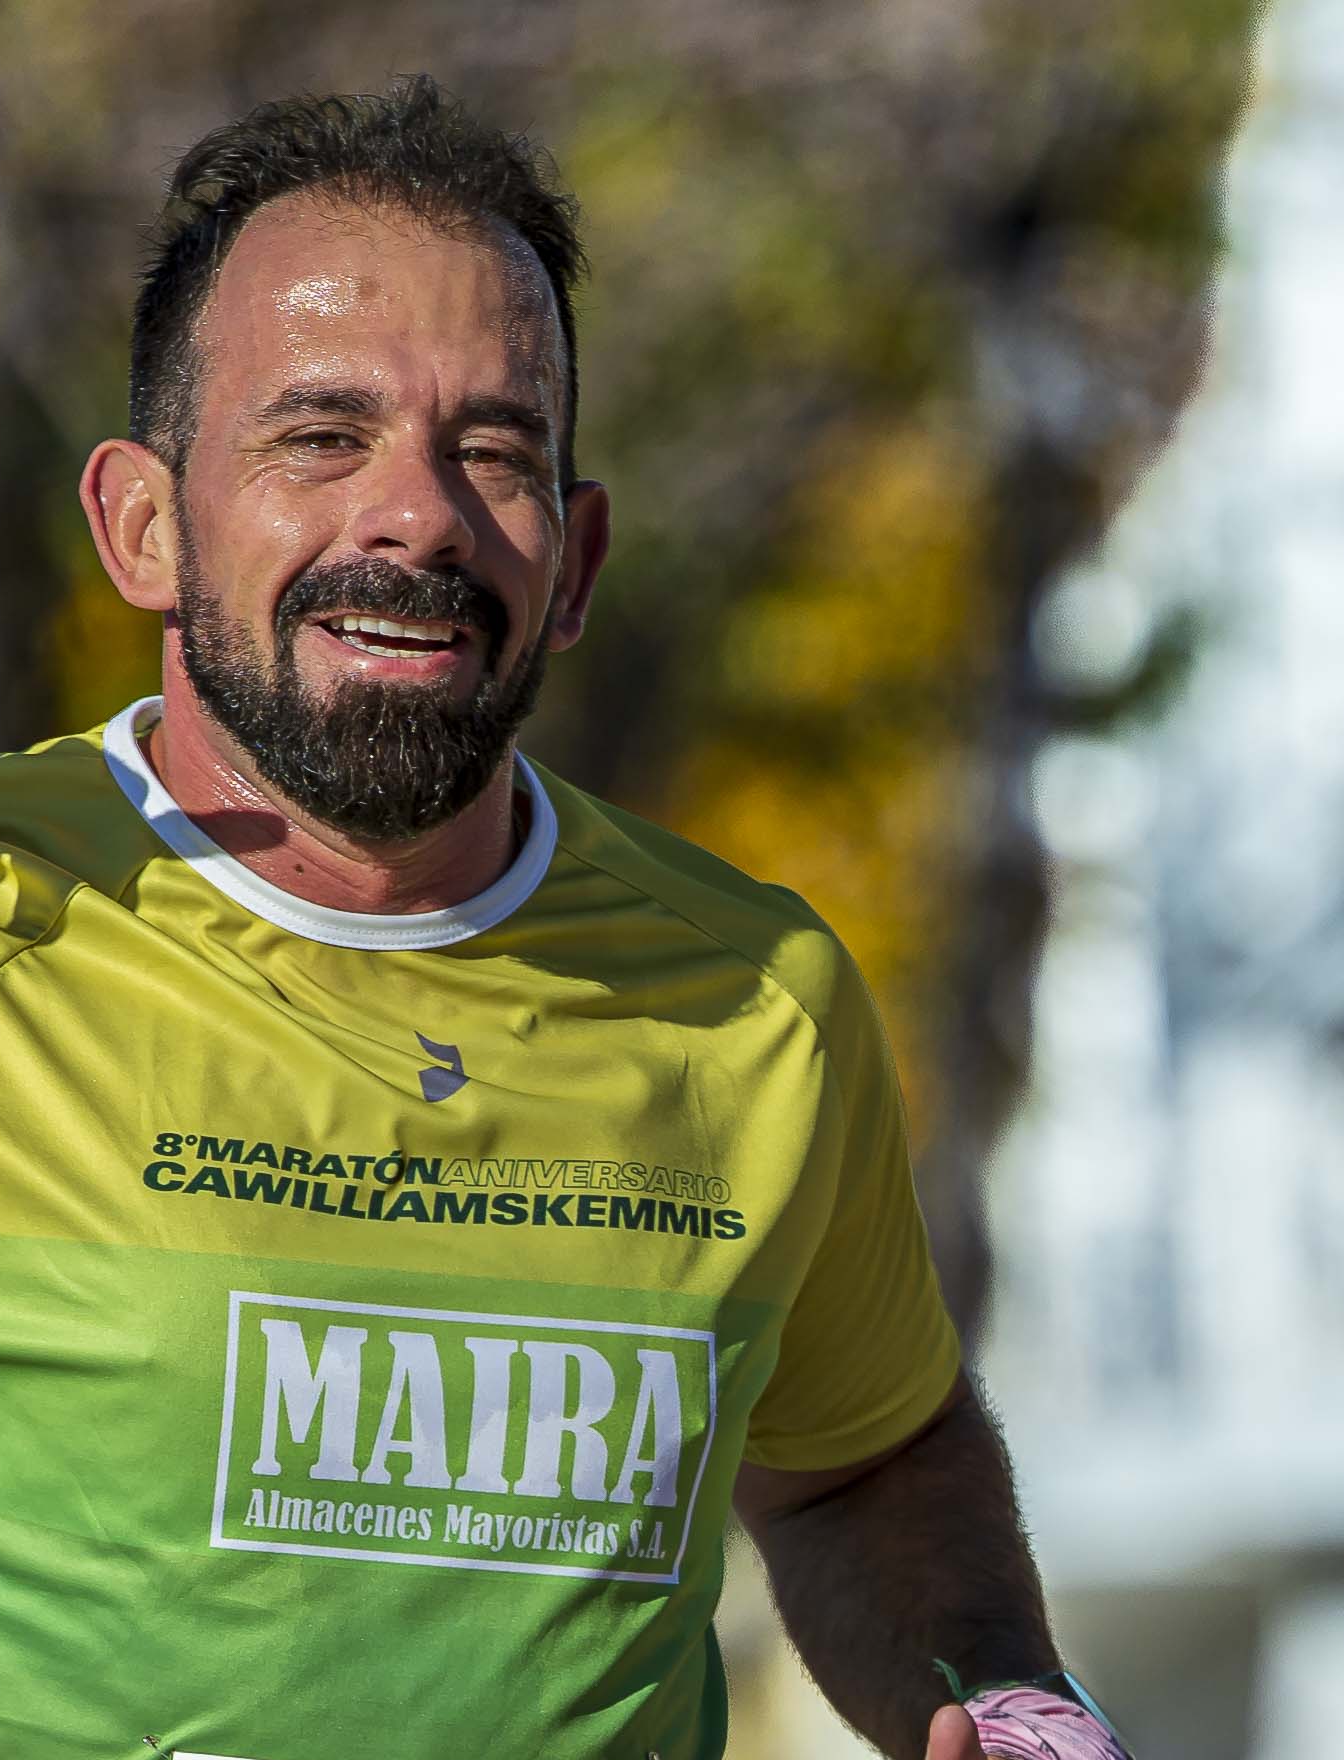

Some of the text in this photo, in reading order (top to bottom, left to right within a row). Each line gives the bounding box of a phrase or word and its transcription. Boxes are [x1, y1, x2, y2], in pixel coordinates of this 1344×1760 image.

[142, 1160, 747, 1241] CAWILLIAMSKEMMIS
[438, 1158, 731, 1205] ANIVERSARIO
[251, 1317, 683, 1508] MAIRA
[243, 1488, 666, 1561] Almacenes Mayoristas S.A.
